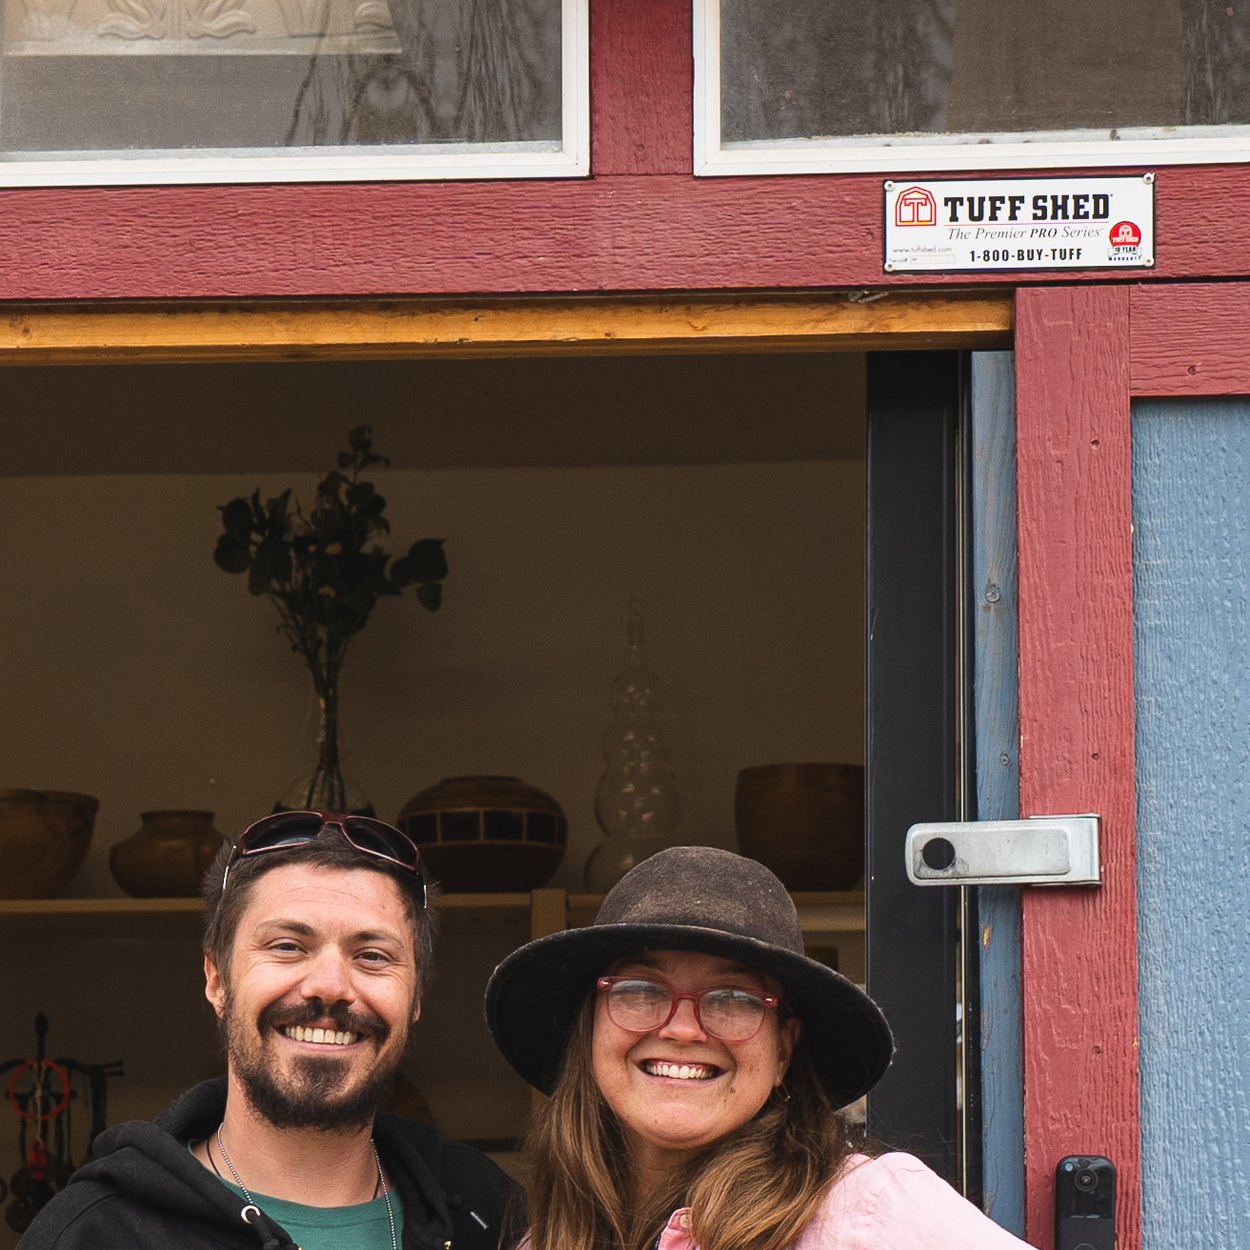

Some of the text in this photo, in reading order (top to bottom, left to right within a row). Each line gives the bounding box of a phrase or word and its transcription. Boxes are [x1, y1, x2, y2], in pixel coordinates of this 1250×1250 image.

[943, 193, 1110, 223] TUFF SHED
[947, 225, 1101, 241] The Premier PRO Series
[969, 248, 1083, 263] 1-800-BUY-TUFF
